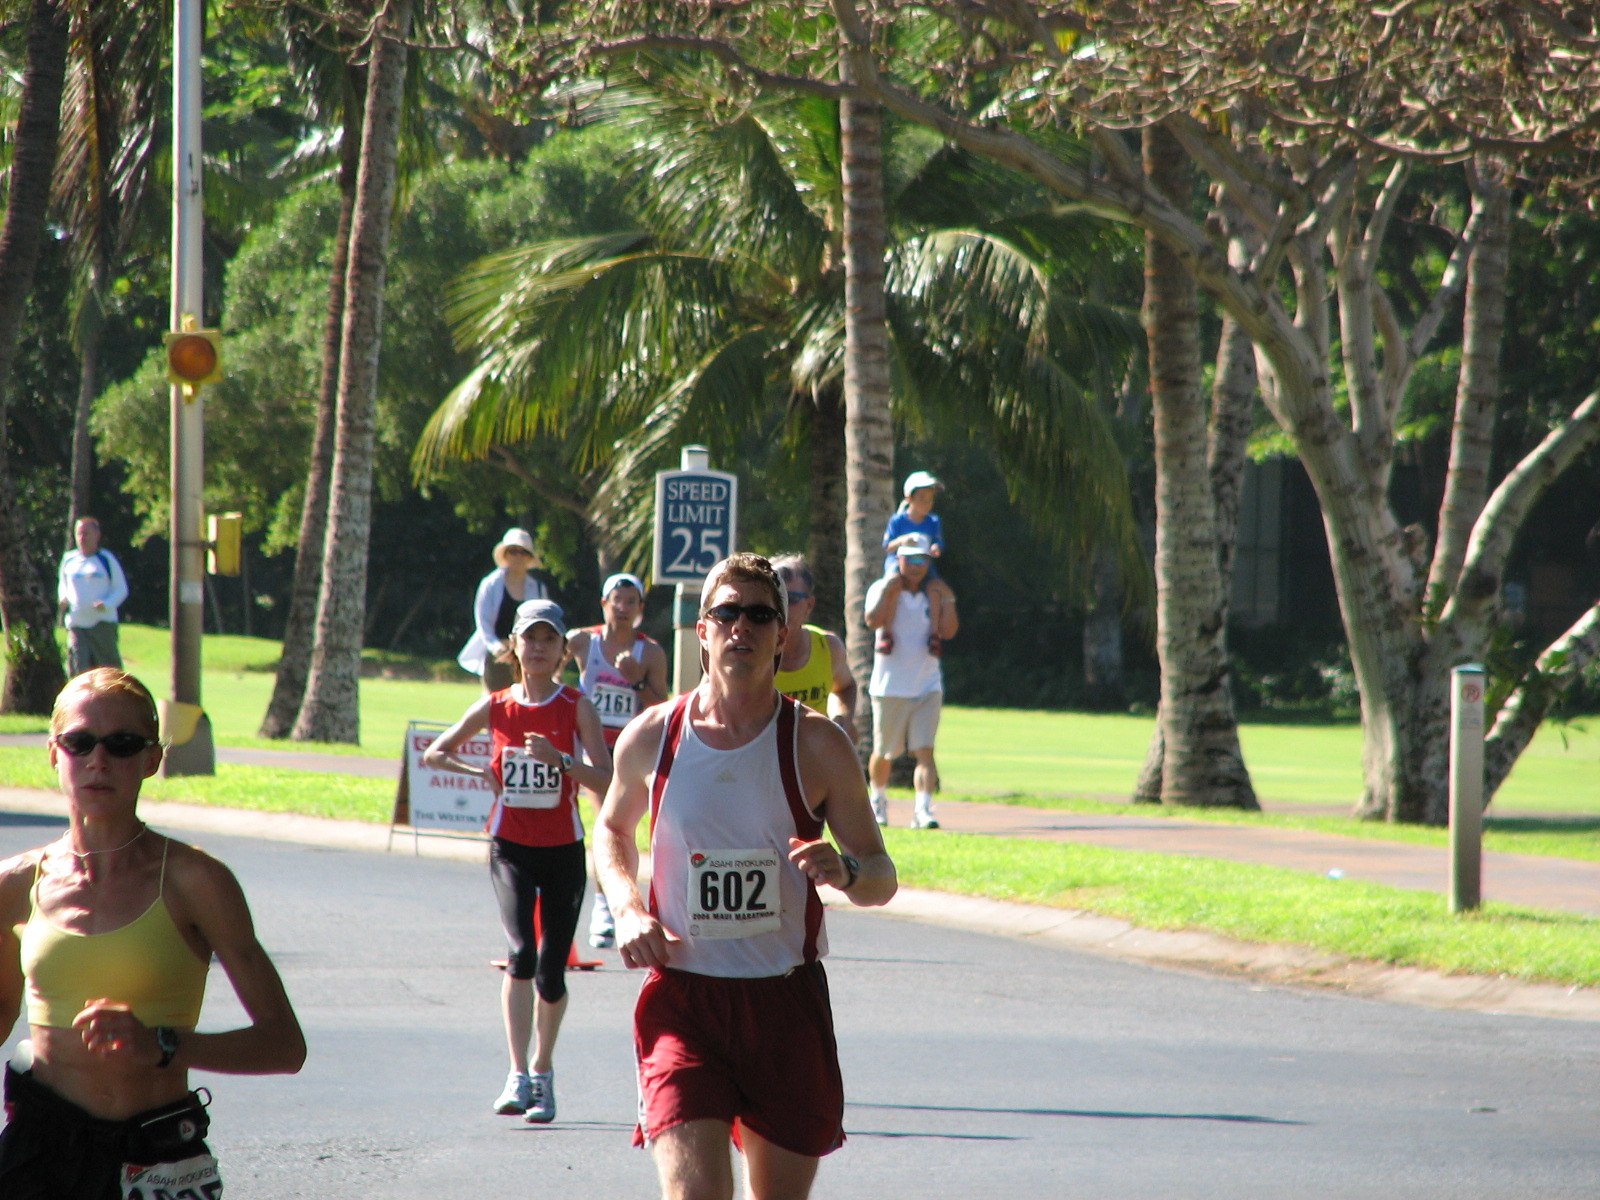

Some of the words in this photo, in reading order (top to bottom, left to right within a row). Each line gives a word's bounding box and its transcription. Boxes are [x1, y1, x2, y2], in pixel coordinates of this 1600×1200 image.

[667, 481, 728, 502] SPEED
[667, 503, 726, 525] LIMIT
[665, 527, 723, 574] 25
[593, 692, 632, 713] 2161
[504, 761, 560, 788] 2155
[709, 860, 733, 868] ASAHI
[700, 869, 767, 912] 602
[713, 912, 732, 920] MAUI
[735, 911, 775, 920] MARATHON
[146, 1174, 177, 1187] ASAHI
